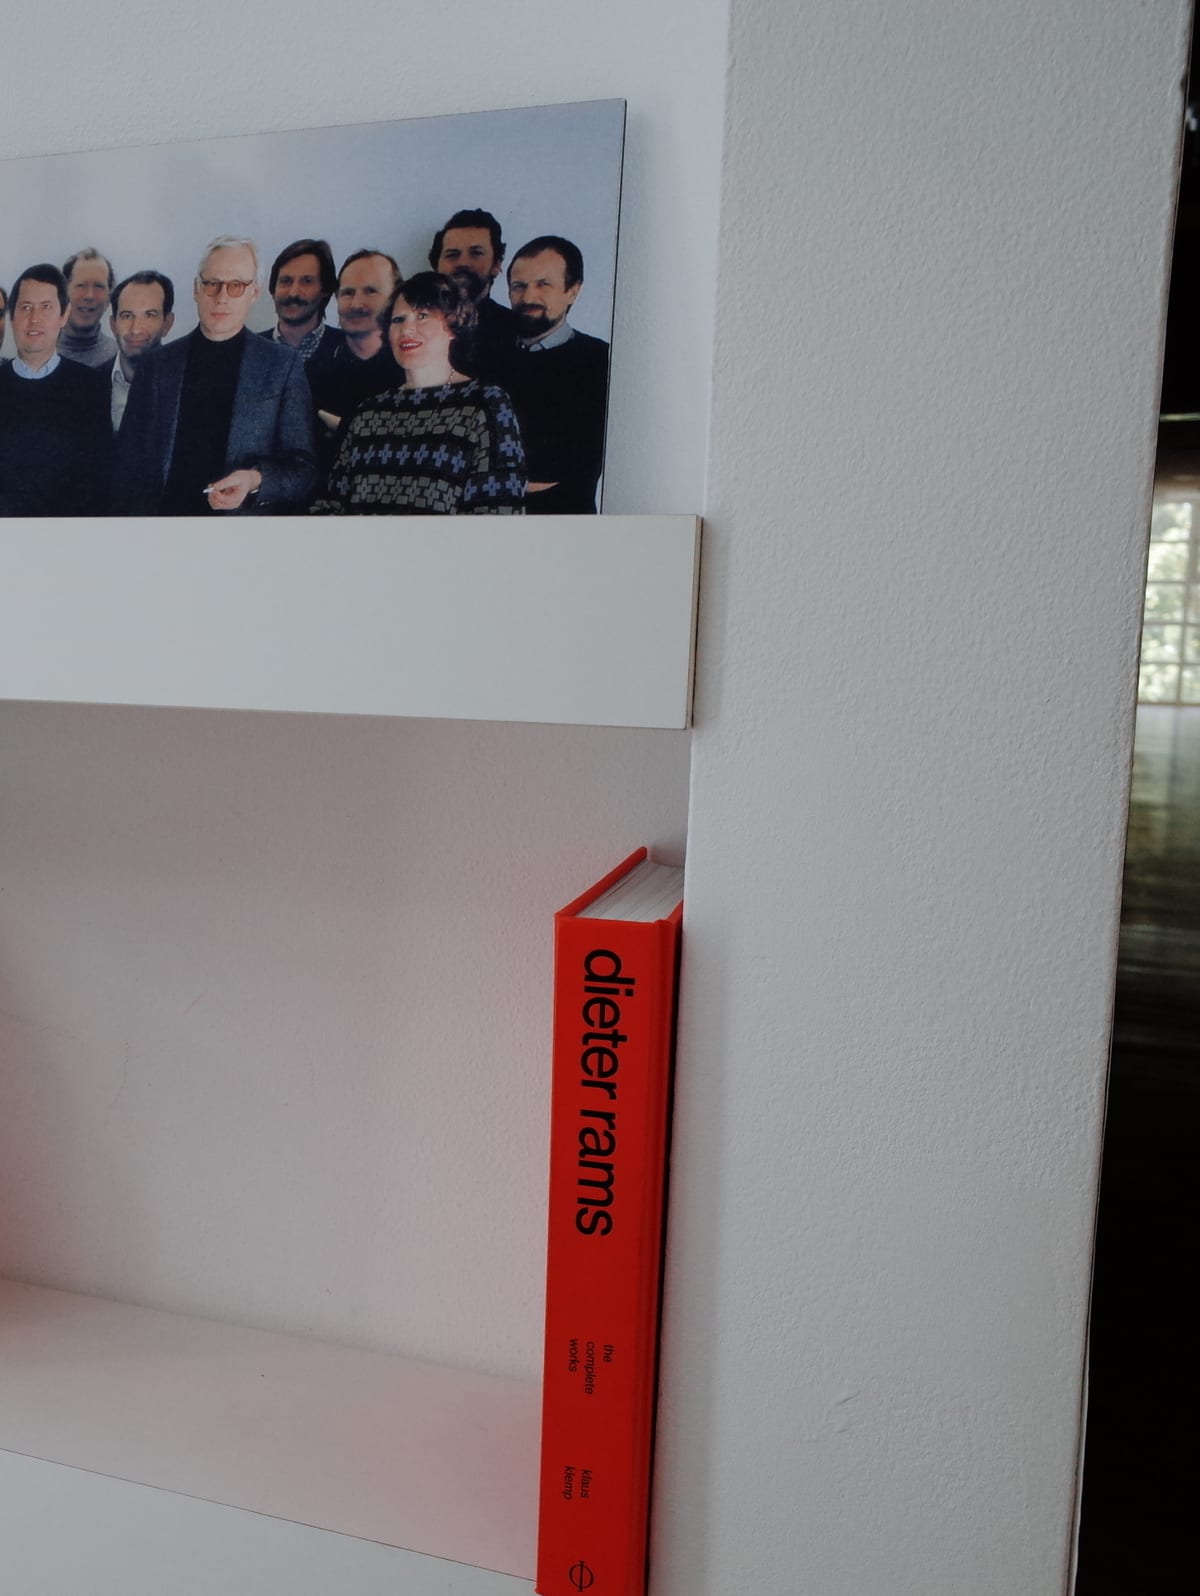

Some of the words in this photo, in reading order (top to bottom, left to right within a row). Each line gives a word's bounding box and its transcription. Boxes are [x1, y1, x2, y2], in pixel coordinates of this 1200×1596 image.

[580, 948, 635, 1100] dieter
[575, 1109, 616, 1236] rams
[568, 1338, 579, 1372] works
[583, 1341, 596, 1395] complete
[602, 1344, 615, 1363] the
[561, 1465, 576, 1500] klemp
[580, 1469, 592, 1499] klaus
